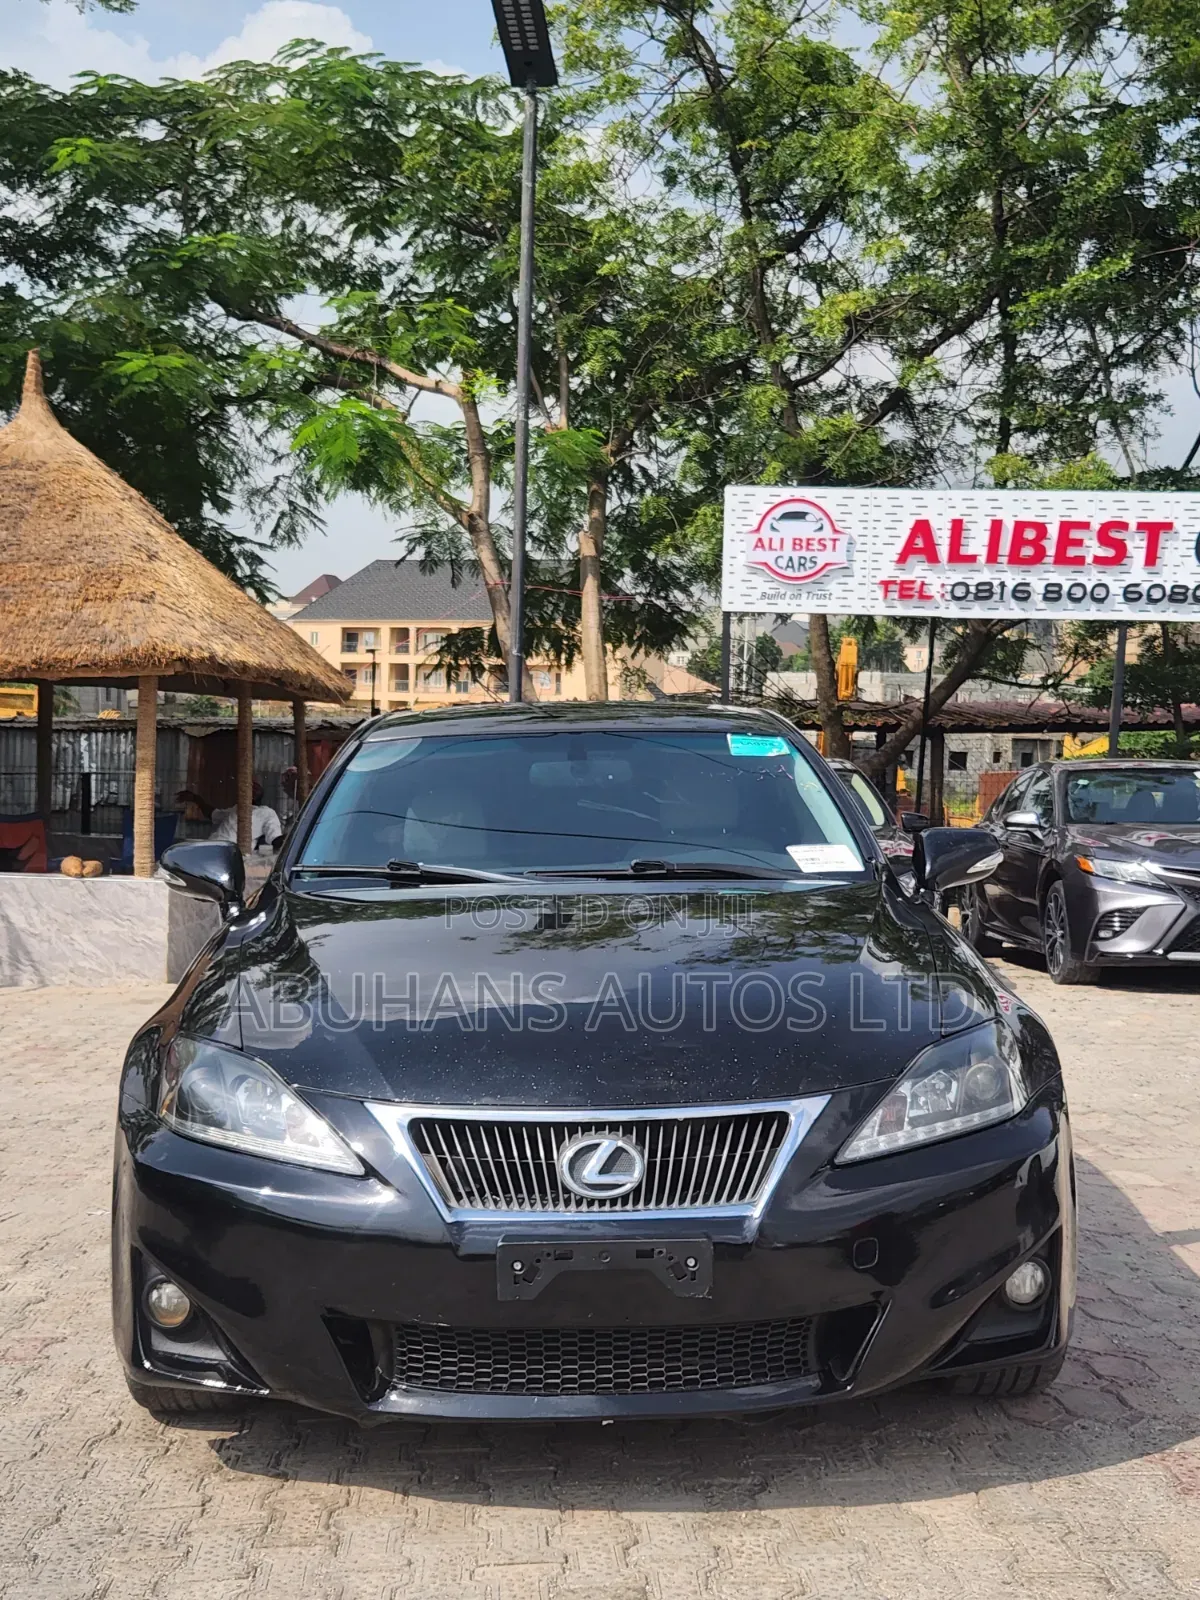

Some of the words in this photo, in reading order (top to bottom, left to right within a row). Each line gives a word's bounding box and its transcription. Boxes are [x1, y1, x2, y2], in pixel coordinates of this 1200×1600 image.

[752, 537, 784, 552] ALI
[791, 537, 840, 552] BEST
[895, 518, 1174, 568] ALIBEST
[774, 555, 818, 573] CARS
[759, 591, 787, 601] Build
[789, 593, 802, 601] on
[806, 591, 833, 601] Trust
[950, 581, 1032, 602] 0816
[1042, 582, 1110, 605] 800
